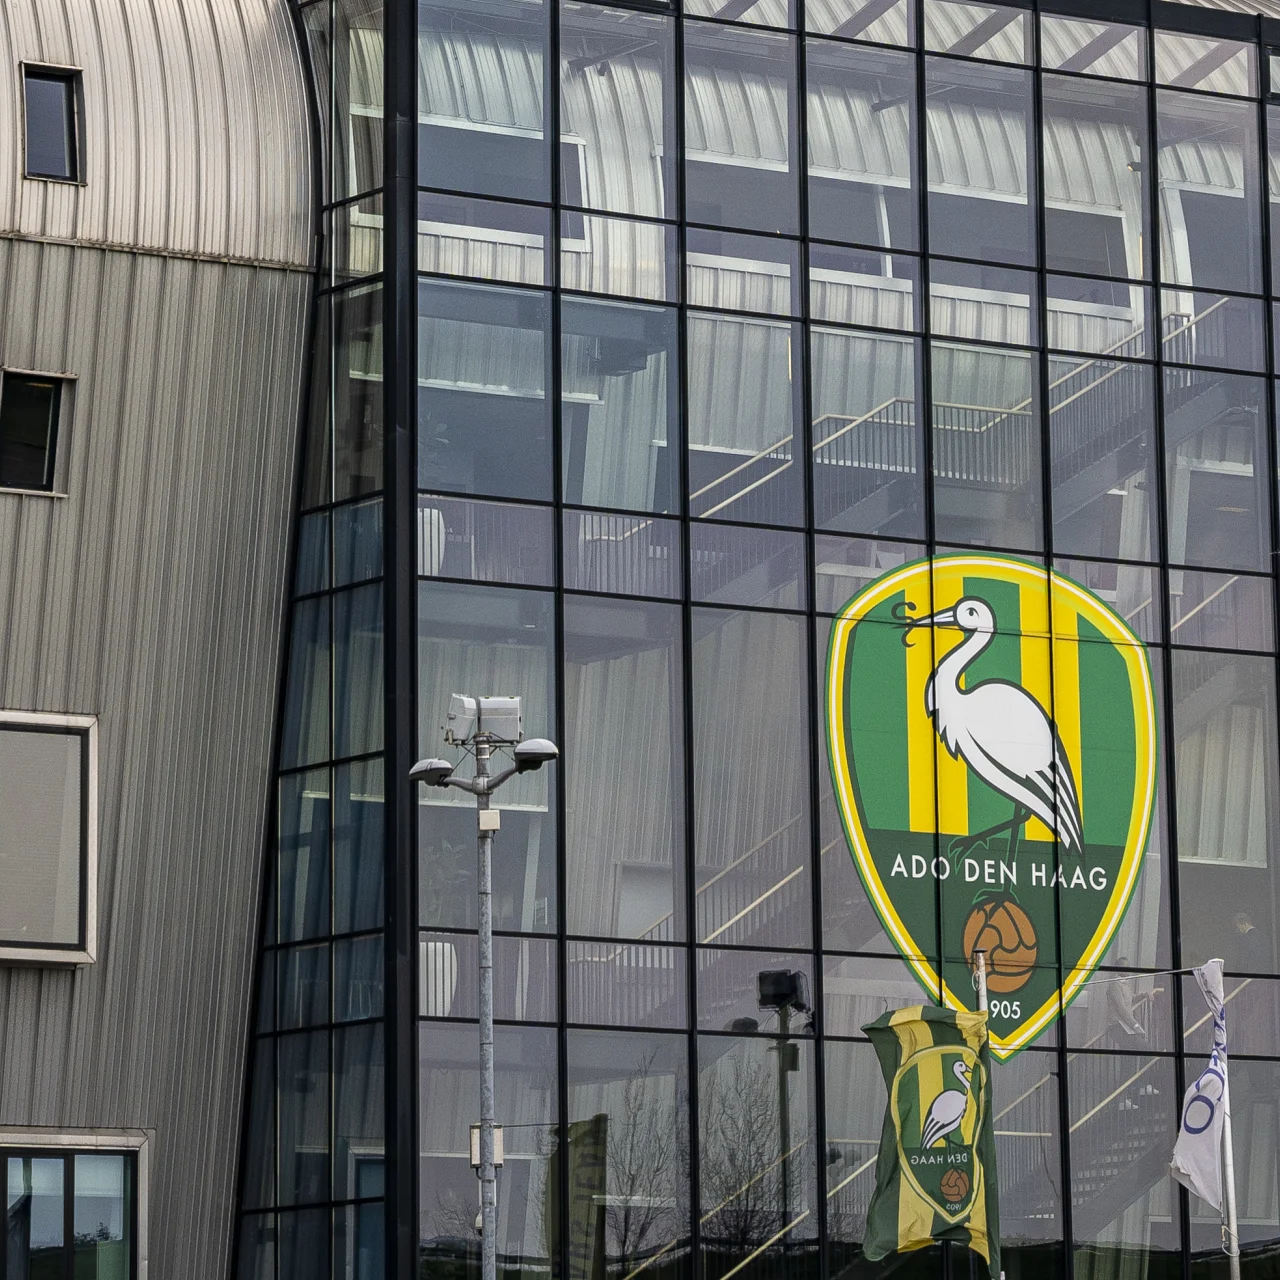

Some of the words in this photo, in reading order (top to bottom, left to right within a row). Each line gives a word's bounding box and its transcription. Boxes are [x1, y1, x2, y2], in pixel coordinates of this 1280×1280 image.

[890, 853, 950, 880] ADO
[964, 858, 1017, 886] DEN
[1031, 862, 1107, 891] HAAG
[989, 1000, 1021, 1019] 905
